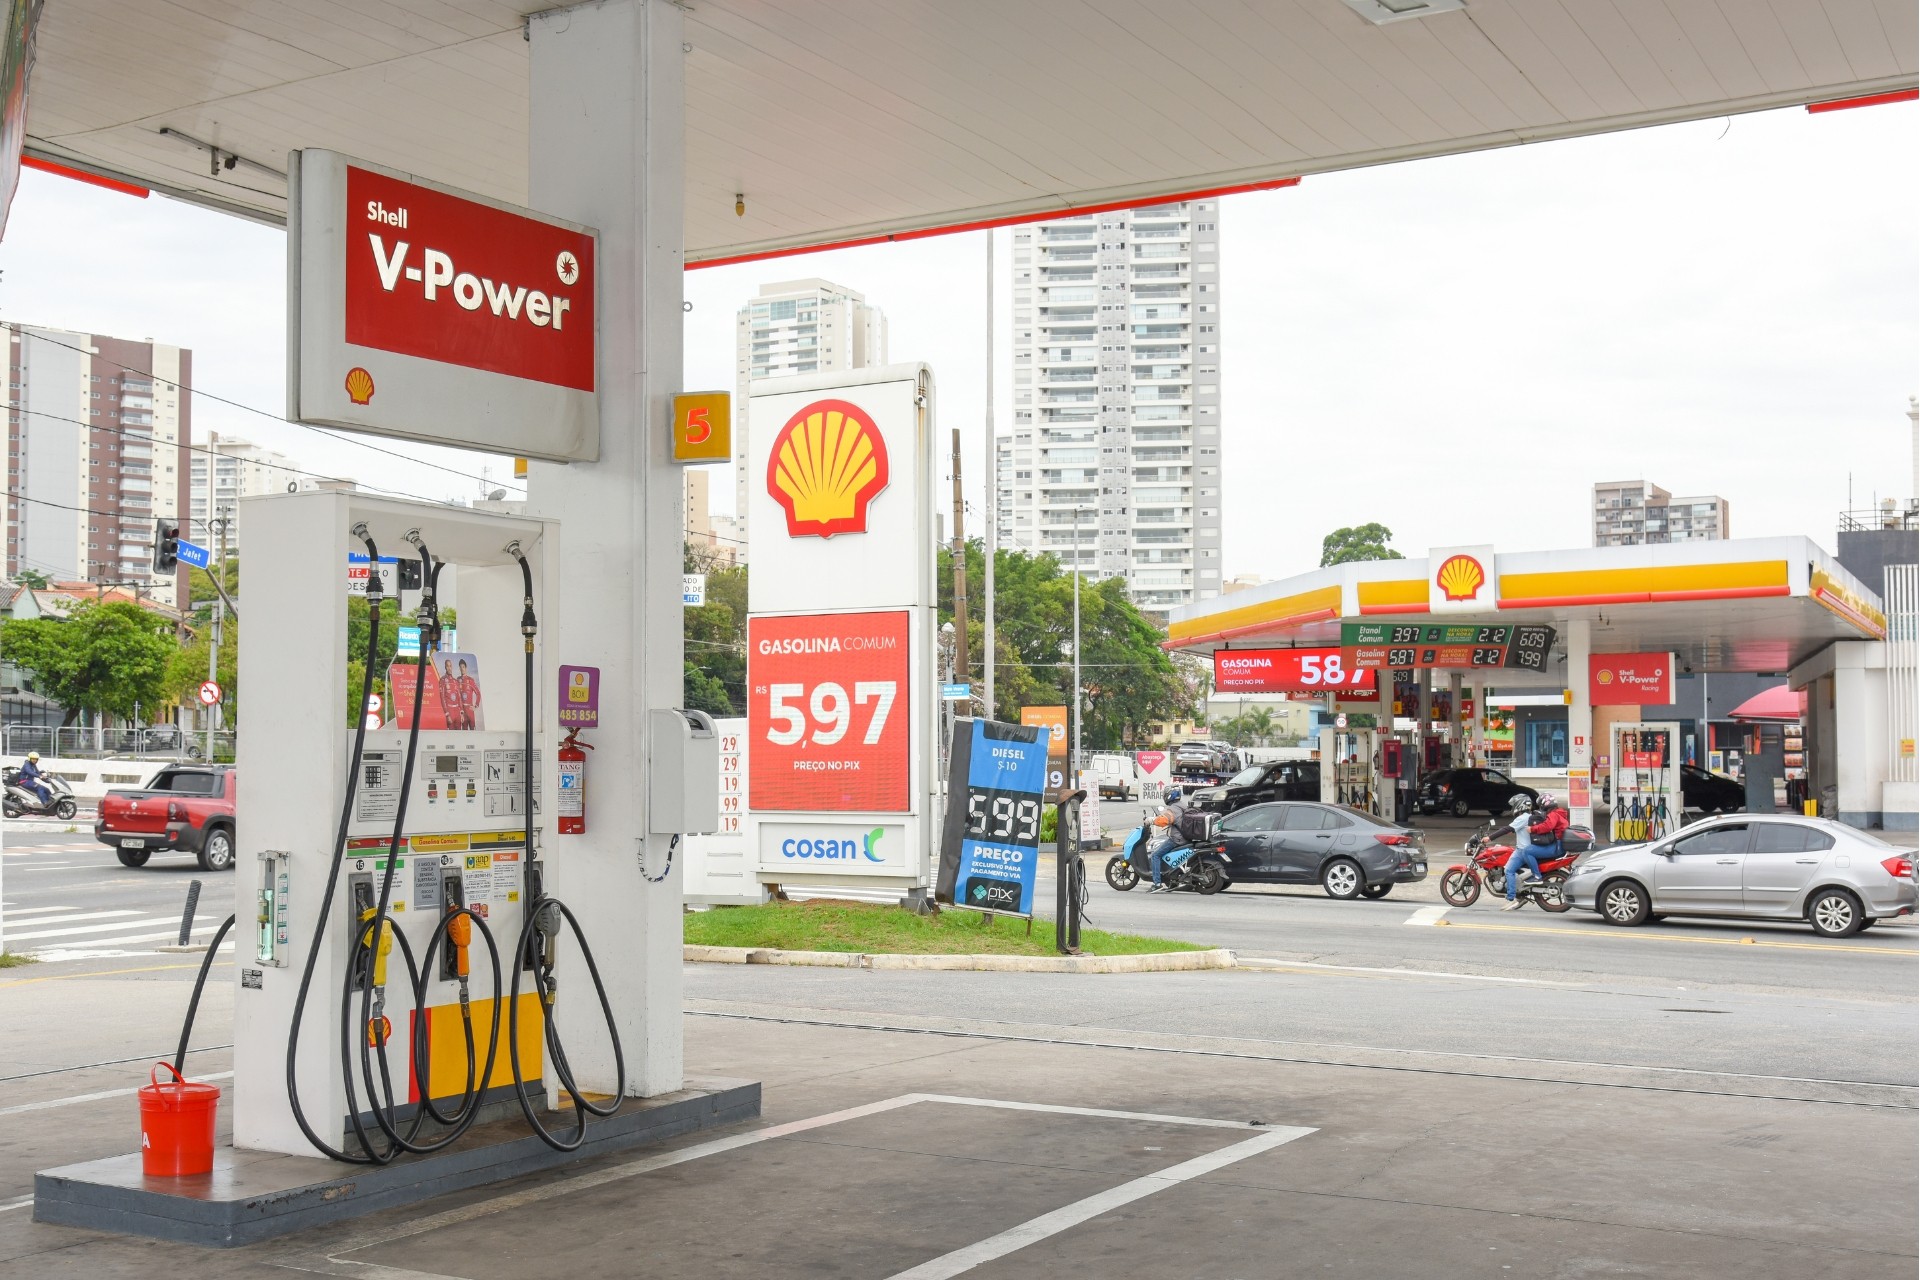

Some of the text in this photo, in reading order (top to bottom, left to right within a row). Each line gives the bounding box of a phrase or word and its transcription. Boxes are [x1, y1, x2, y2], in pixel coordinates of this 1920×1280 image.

[367, 200, 408, 229] Shell
[368, 231, 570, 331] V-Power
[686, 406, 711, 444] 5
[183, 548, 201, 561] Jafet
[1359, 625, 1381, 634] Etanol
[759, 636, 896, 655] GASOLINA COMUM
[1358, 635, 1383, 643] Comum
[1356, 649, 1385, 658] Gasolina
[1221, 658, 1272, 668] GASOLINA
[1356, 658, 1380, 667] Comum
[1619, 676, 1660, 684] V-Power
[571, 689, 585, 699] BOX
[559, 709, 597, 721] 485 854
[755, 680, 897, 749] R$ 5,97
[722, 736, 737, 751] 29
[992, 747, 1025, 760] DIESEL
[723, 757, 737, 771] 29
[793, 761, 860, 772] PREÇO NO PIX
[997, 761, 1017, 772] S-10
[724, 777, 738, 791] 19
[1142, 782, 1157, 791] SEM
[724, 797, 738, 811] 99
[724, 817, 738, 831] 19
[782, 836, 856, 860] cosan
[476, 855, 489, 865] anp
[973, 846, 1023, 864] PREÇO
[356, 861, 364, 869] 15
[971, 861, 1004, 870] EXCLUSIVO
[970, 867, 1008, 877] PAGAMENTO
[987, 886, 1014, 901] pix
[142, 1131, 151, 1149] A
